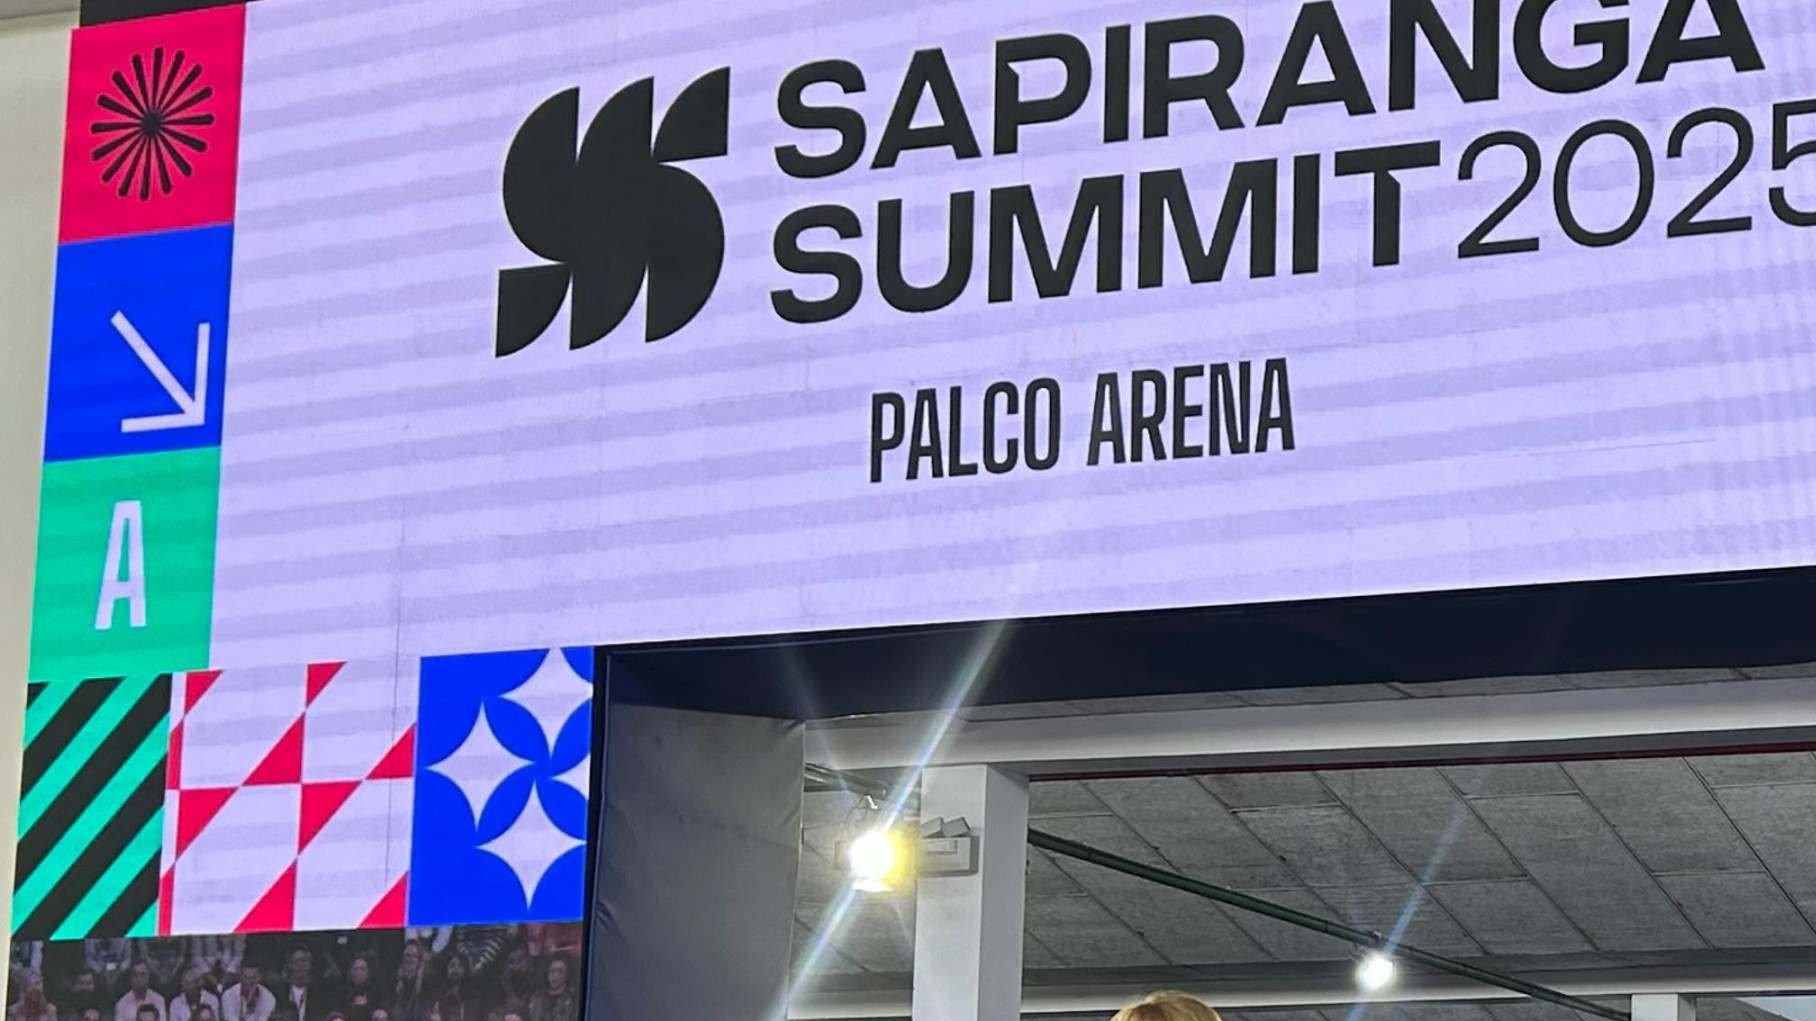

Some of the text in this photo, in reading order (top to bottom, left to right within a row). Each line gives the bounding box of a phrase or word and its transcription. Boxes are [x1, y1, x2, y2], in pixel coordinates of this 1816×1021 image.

[774, 0, 1766, 179] SAPIRANGA
[870, 357, 1296, 484] PALCO ARENA
[96, 501, 146, 629] A
